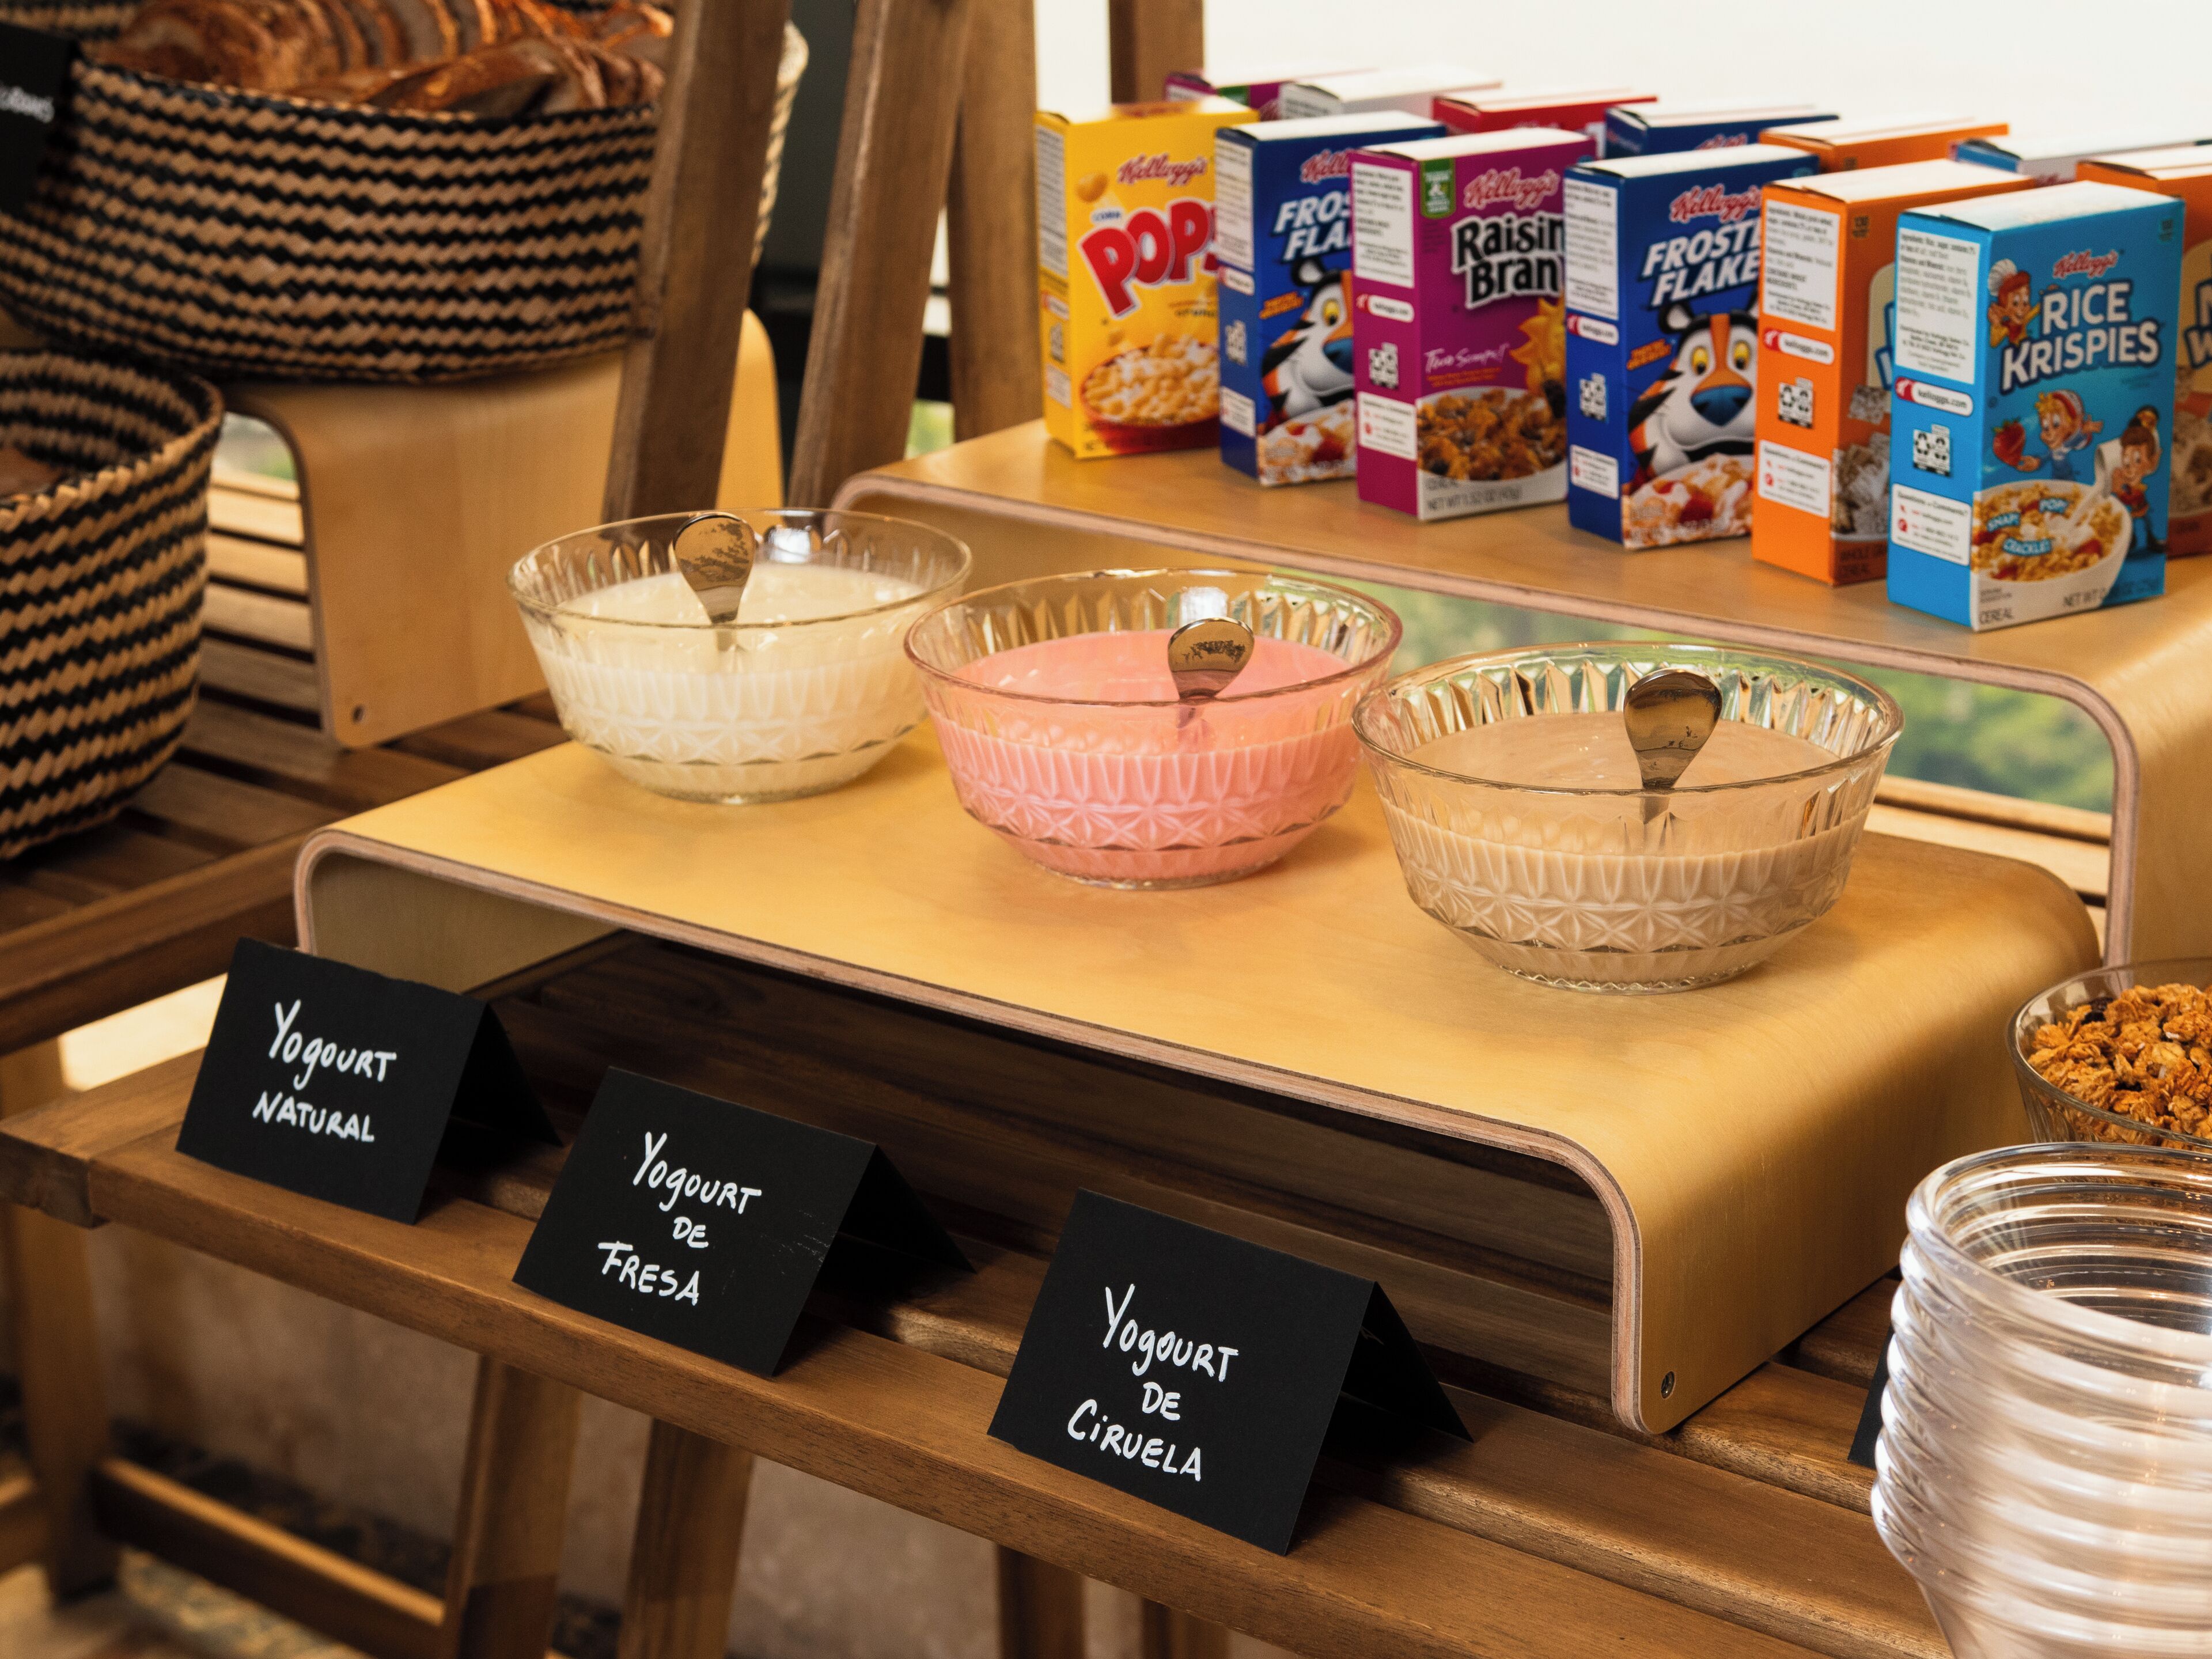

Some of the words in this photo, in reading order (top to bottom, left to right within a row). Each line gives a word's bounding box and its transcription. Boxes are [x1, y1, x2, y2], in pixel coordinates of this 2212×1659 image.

[1117, 153, 1208, 187] Kellogg's
[1300, 148, 1351, 185] Kell
[1463, 166, 1560, 210] Kellogg's
[1454, 213, 1565, 270] Raisin
[2052, 249, 2119, 279] Kellogg's
[1469, 257, 1559, 304] Bran
[1651, 250, 1761, 306] FLAKE
[2041, 282, 2130, 335] RICE
[2001, 320, 2159, 392] KRISPIES
[252, 1091, 374, 1142] NATURAL
[672, 1216, 709, 1248] DE
[597, 1240, 700, 1306] FRESA
[1142, 1381, 1181, 1421] DE
